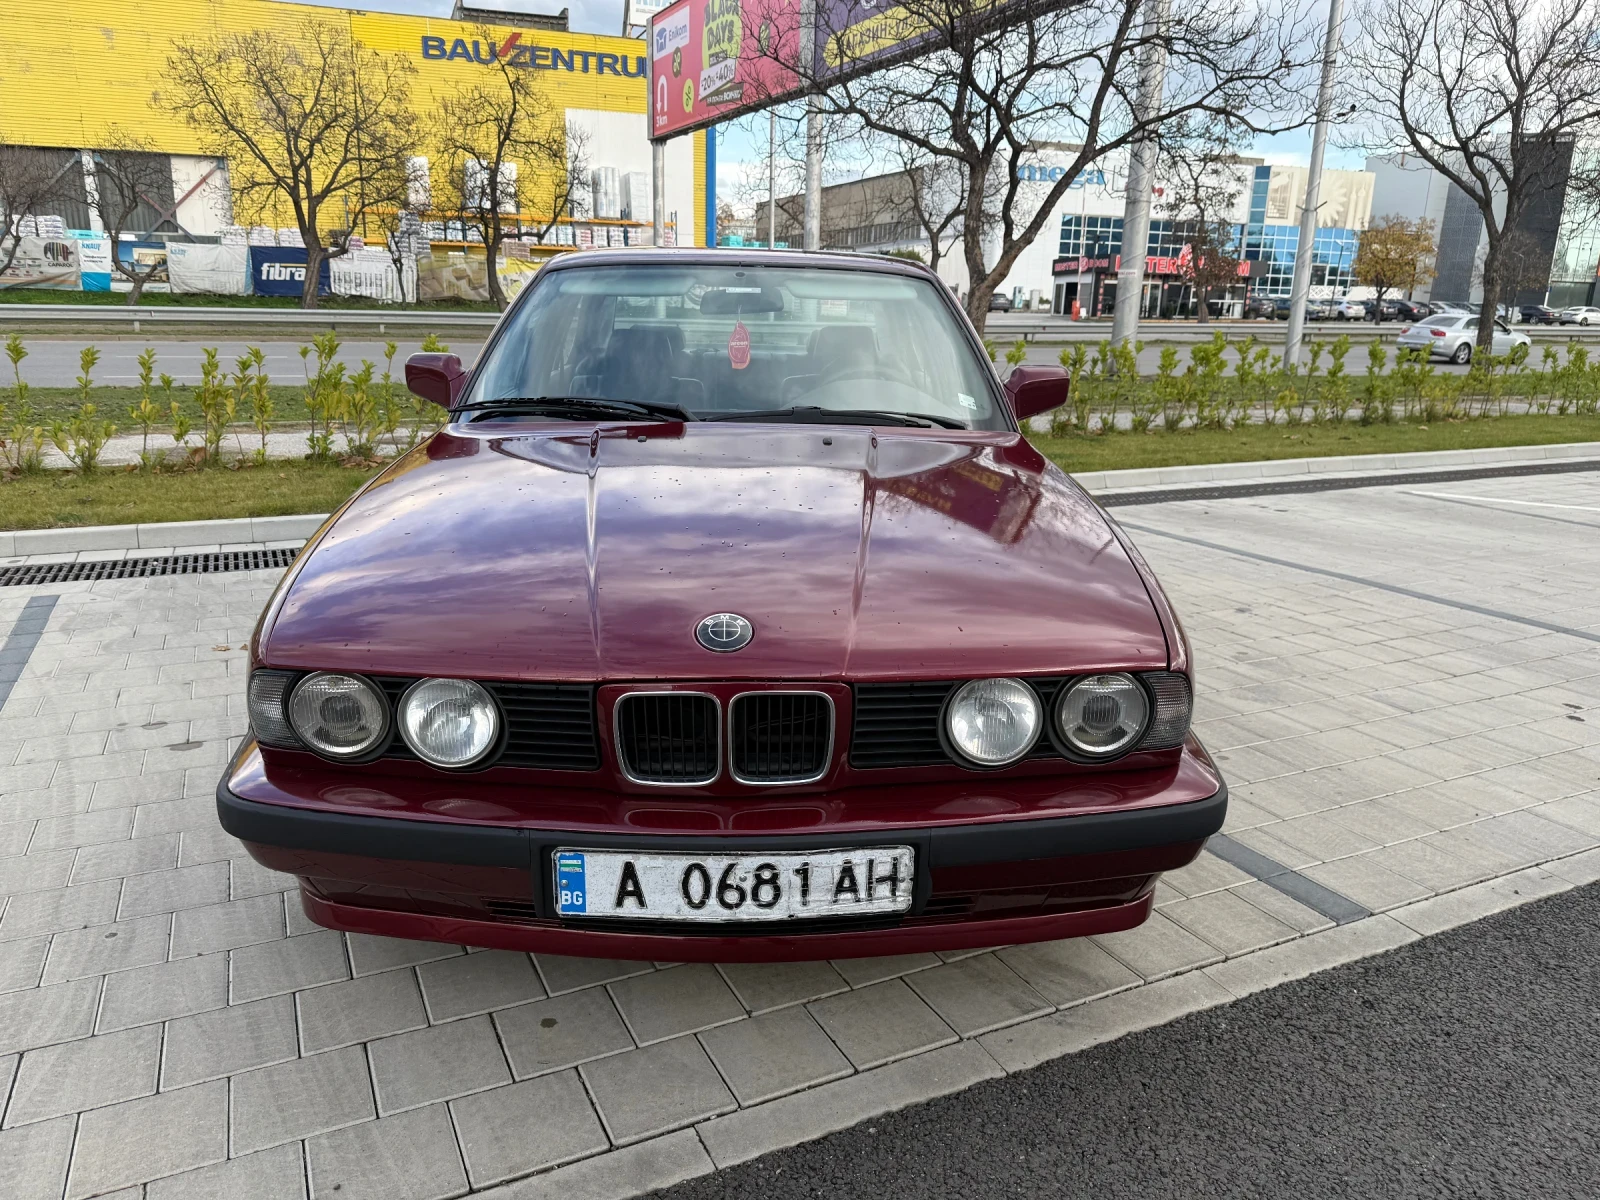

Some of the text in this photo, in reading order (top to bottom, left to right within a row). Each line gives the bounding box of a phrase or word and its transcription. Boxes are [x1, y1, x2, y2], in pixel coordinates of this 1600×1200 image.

[668, 23, 688, 41] Enikom
[707, 19, 735, 51] DAYS
[421, 36, 496, 65] BAU
[81, 241, 102, 251] KNAUF
[704, 615, 747, 626] BMW
[614, 855, 900, 911] A 0681 AH
[561, 890, 583, 906] BG
